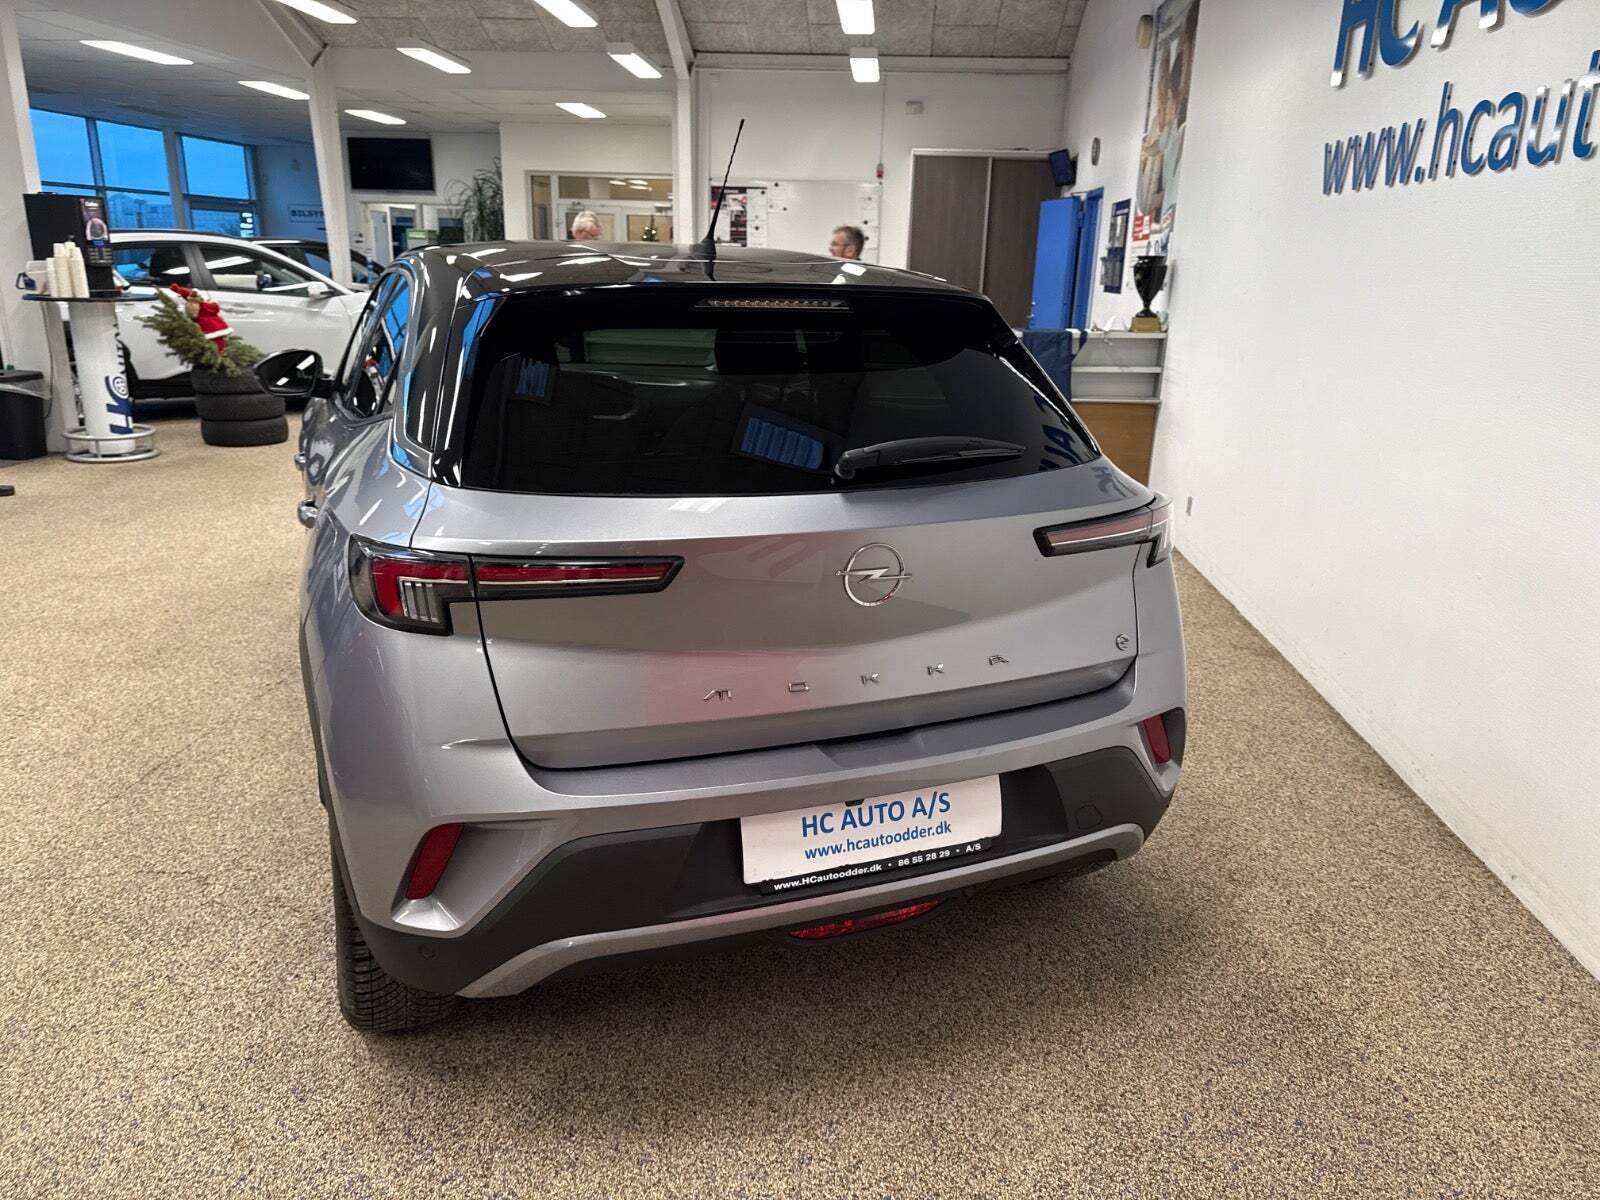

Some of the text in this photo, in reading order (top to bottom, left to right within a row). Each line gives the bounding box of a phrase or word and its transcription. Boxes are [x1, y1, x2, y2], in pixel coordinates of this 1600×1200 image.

[801, 791, 951, 838] HC AUTO A/S
[804, 820, 952, 860] www.hcautoodder.dk
[773, 842, 982, 891] www.HCautoodder.dk 86 55 28 29 A/S
